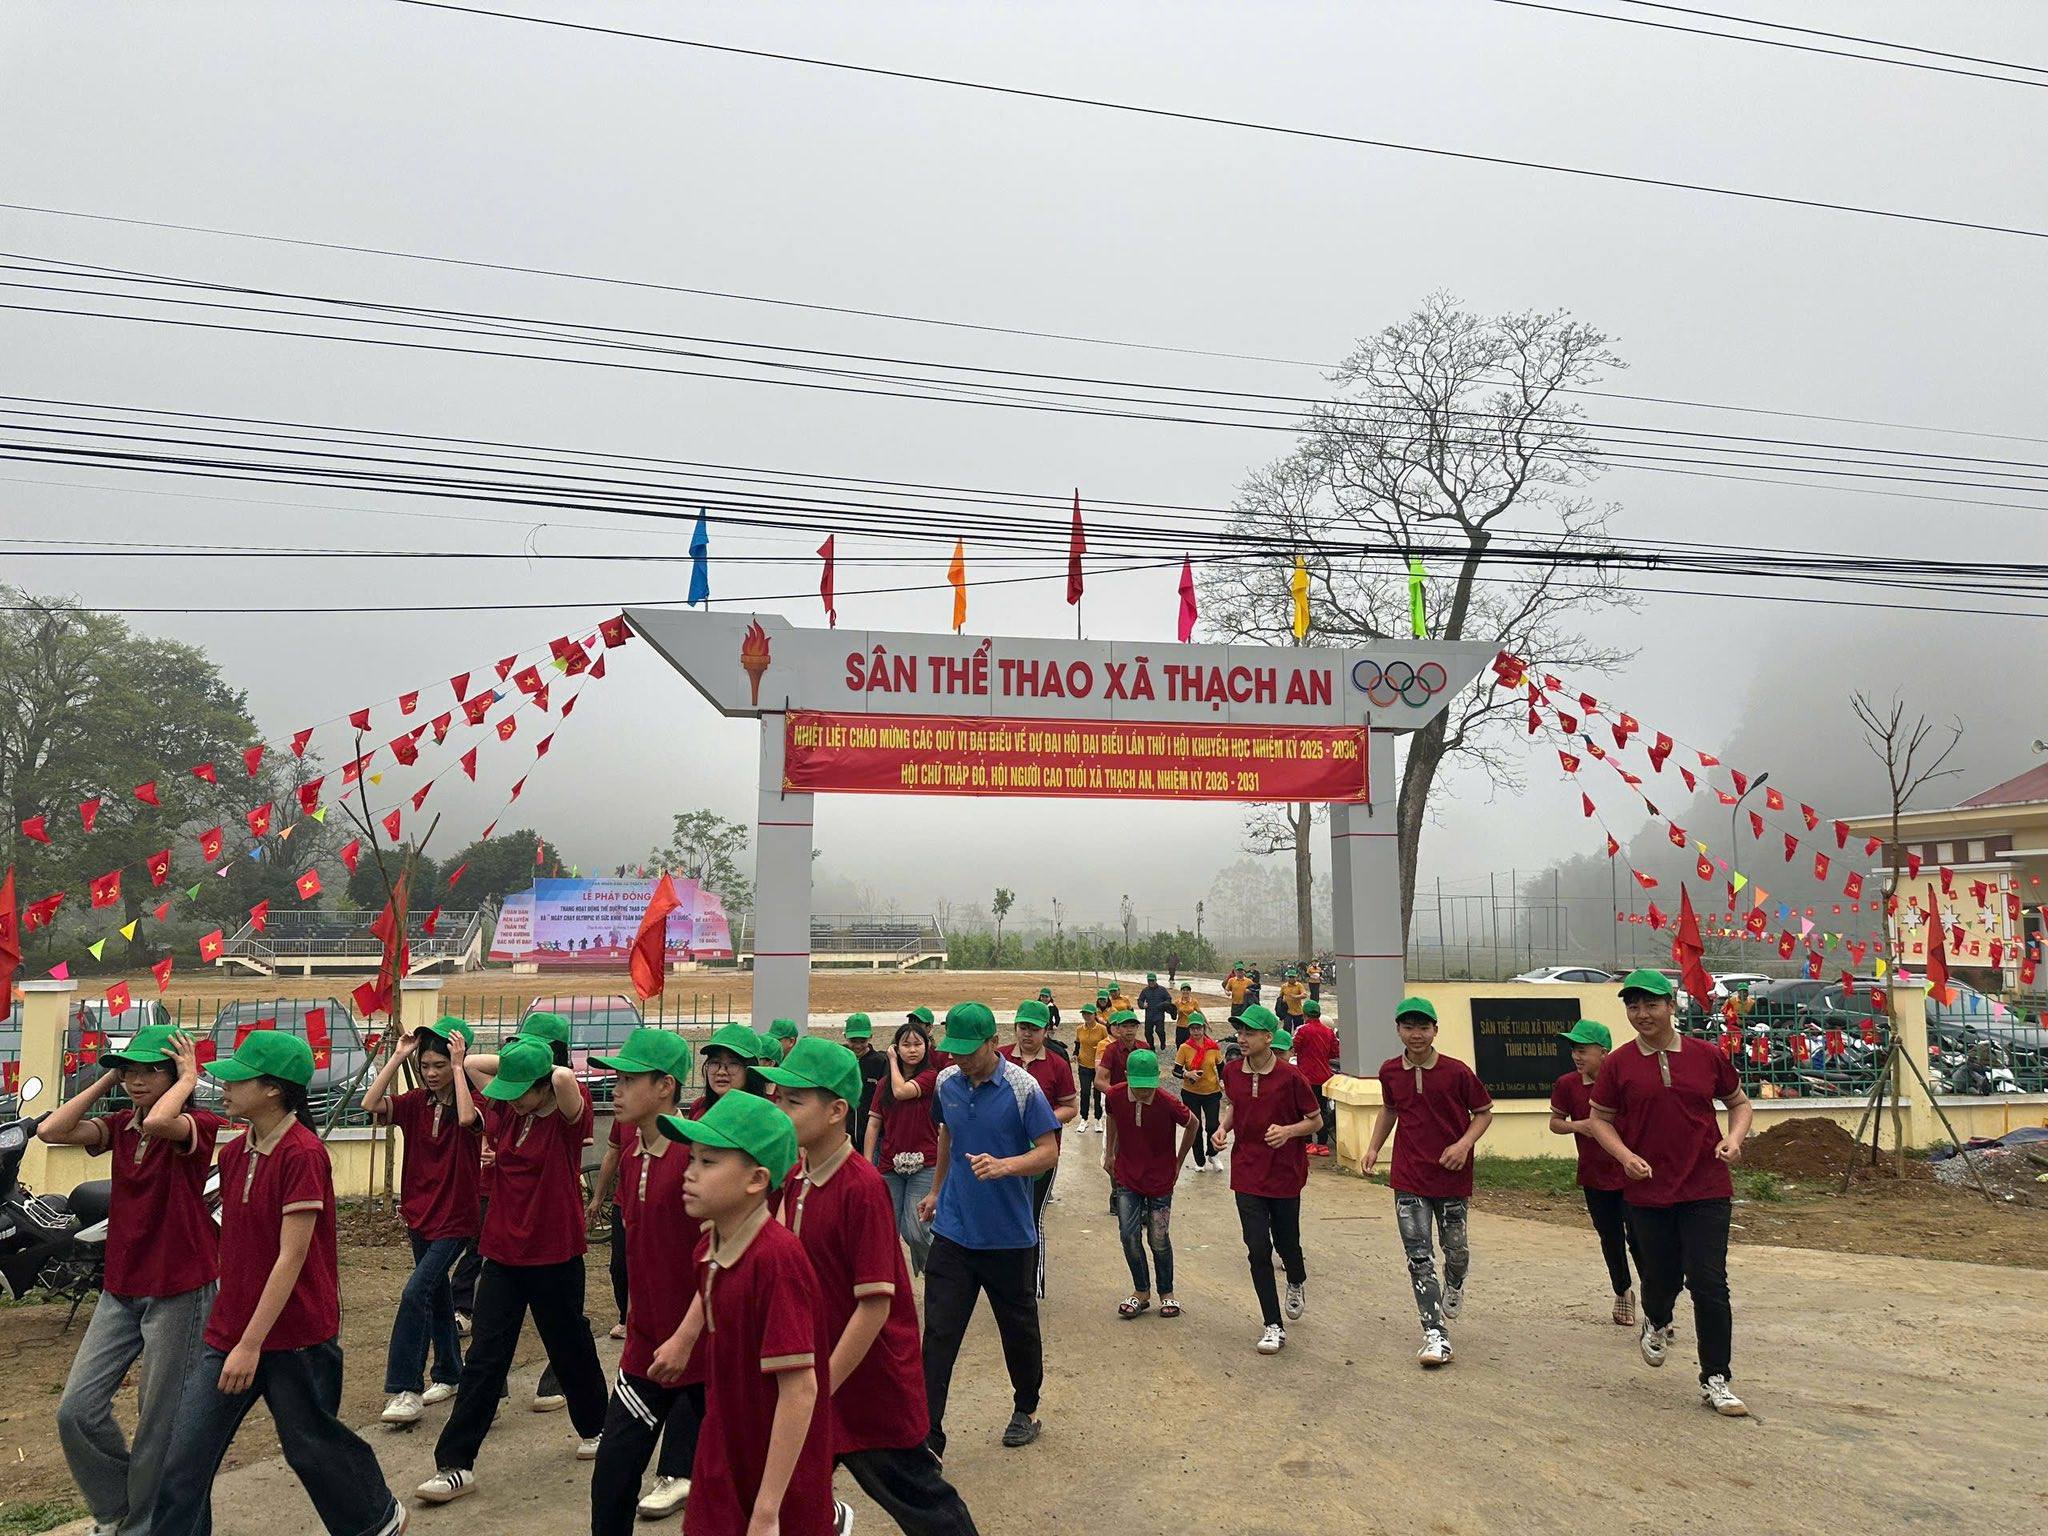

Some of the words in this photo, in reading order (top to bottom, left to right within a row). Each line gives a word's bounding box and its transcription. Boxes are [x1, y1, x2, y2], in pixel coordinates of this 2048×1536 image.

[846, 644, 917, 692] SÂN
[928, 638, 992, 695] THỂ
[998, 659, 1093, 698] THAO
[1103, 656, 1155, 700] XÃ
[1163, 664, 1276, 711] THẠCH
[1285, 668, 1332, 705] AN
[794, 722, 823, 751] NHIỆT
[826, 723, 847, 751] LIỆT
[850, 724, 876, 749] CHÀO
[880, 724, 910, 749] MỪNG
[913, 725, 933, 750] CÁC
[936, 726, 955, 752] QUÝ
[958, 730, 967, 755] VỊ
[970, 731, 987, 755] ĐẠI
[990, 723, 1011, 752] BIỂU
[1014, 726, 1026, 752] VỀ
[1029, 731, 1044, 757] DỰ
[1045, 733, 1061, 758] ĐẠI
[1064, 730, 1080, 758] HỘI
[1082, 734, 1099, 758] ĐẠI
[1102, 727, 1123, 755] BIỂU
[1126, 728, 1145, 755] LẦN
[1147, 732, 1166, 756] THỨ
[1168, 736, 1171, 756] I
[1174, 732, 1189, 760] HỘI
[1192, 732, 1229, 757] KHUYẾN
[1231, 738, 1250, 762] HỌC
[1253, 735, 1283, 762] NHIỆM
[1286, 736, 1297, 759] KỲ
[1300, 740, 1323, 759] 2025
[1332, 740, 1358, 761] 2030;
[901, 760, 917, 790] HỘI
[922, 761, 942, 784] CHỮ
[944, 761, 968, 789] THẬP
[972, 760, 988, 788] ĐỎ,
[991, 762, 1007, 790] HỘI
[1010, 762, 1040, 787] NGƯỜI
[1044, 767, 1062, 788] CAO
[1065, 760, 1087, 788] TUỔI
[1089, 765, 1102, 788] XÃ
[1105, 769, 1135, 793] THẠCH
[1138, 769, 1155, 791] AN,
[1157, 766, 1188, 794] NHIỆM
[1191, 767, 1202, 790] KỲ
[1205, 771, 1228, 791] 2026
[1237, 772, 1260, 791] 2031
[595, 890, 619, 900] PHÁT
[1480, 1018, 1496, 1035] SÂN
[1497, 1016, 1511, 1034] THỂ
[1512, 1020, 1530, 1034] THAO
[1531, 1018, 1541, 1034] XÃ
[1523, 1042, 1537, 1056] CAO
